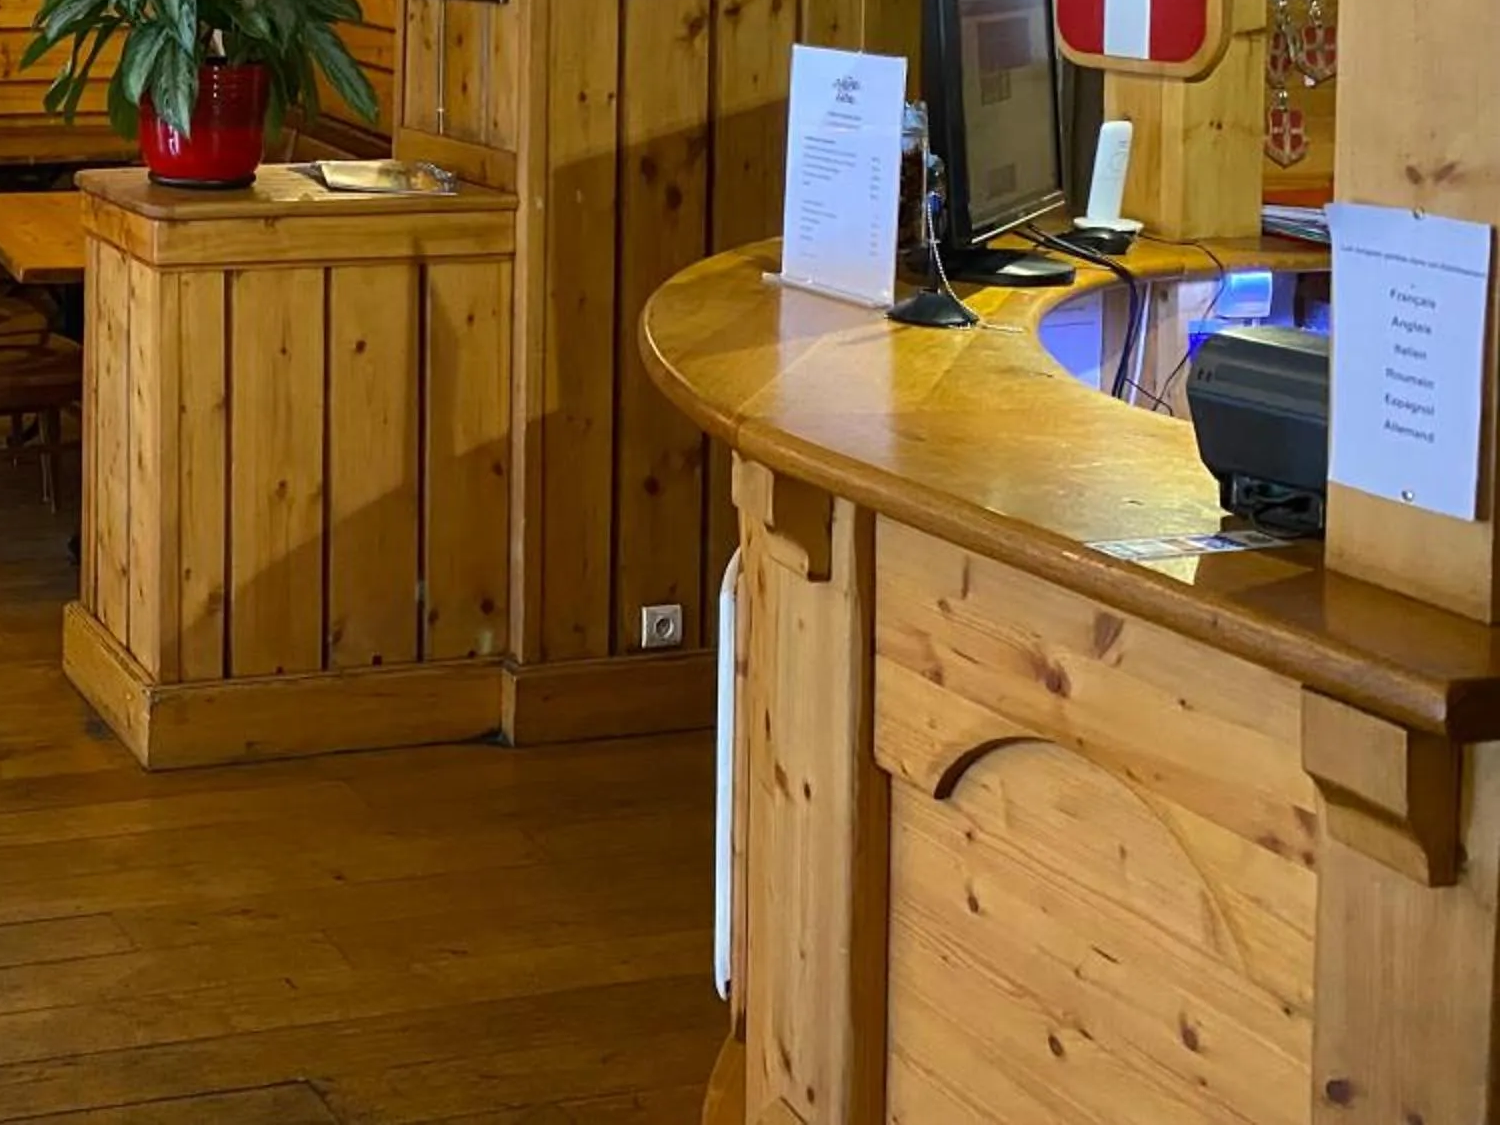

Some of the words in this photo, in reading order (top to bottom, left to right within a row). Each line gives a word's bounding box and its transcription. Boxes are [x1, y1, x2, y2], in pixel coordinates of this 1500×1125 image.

[1389, 288, 1437, 310] Français
[1391, 316, 1432, 335] Anglais
[1384, 420, 1435, 443] Allemand
